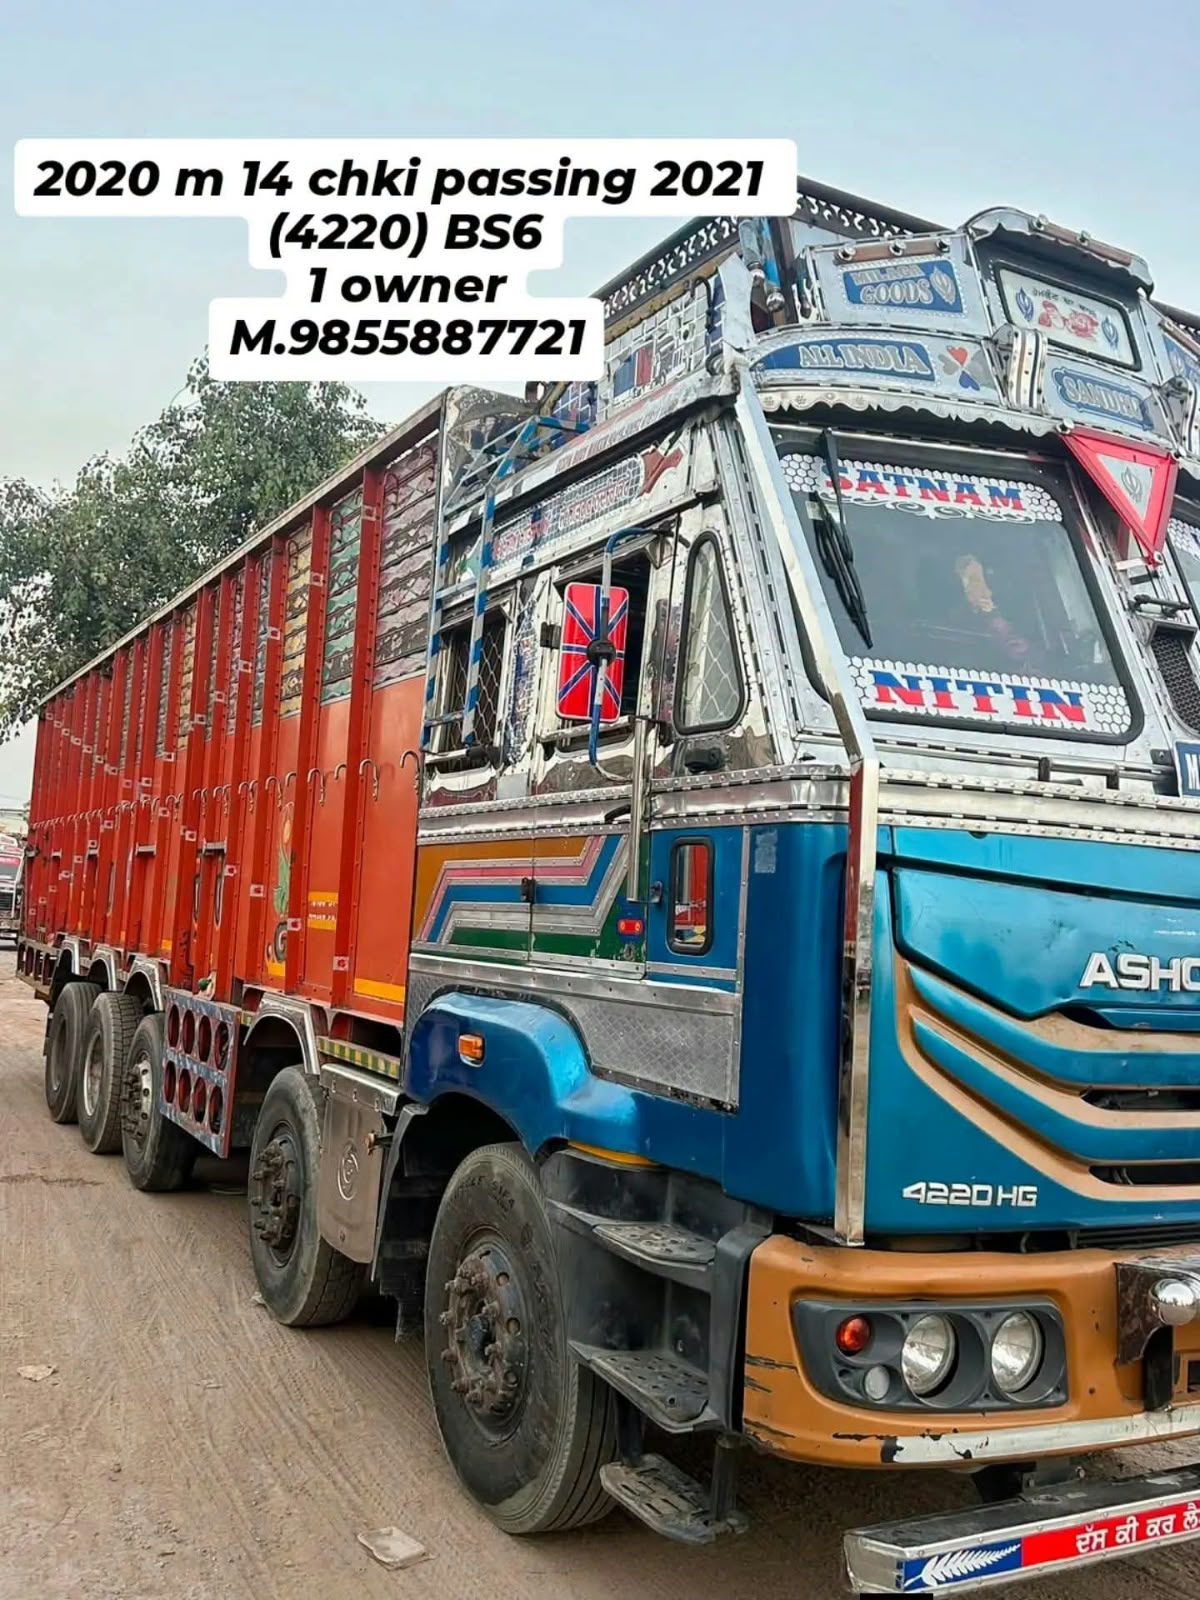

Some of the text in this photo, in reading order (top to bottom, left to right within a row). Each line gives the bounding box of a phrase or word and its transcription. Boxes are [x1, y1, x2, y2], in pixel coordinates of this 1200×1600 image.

[860, 278, 934, 304] GOODS
[799, 344, 932, 375] ALL INDIA
[822, 464, 1026, 511] SATNAM
[868, 670, 1087, 723] NITIN
[902, 1181, 1038, 1207] 4220 HG
[1115, 1515, 1139, 1544] ਕੀ
[1146, 1513, 1176, 1537] ਕਰ
[1183, 1502, 1200, 1530] ਲੈ
